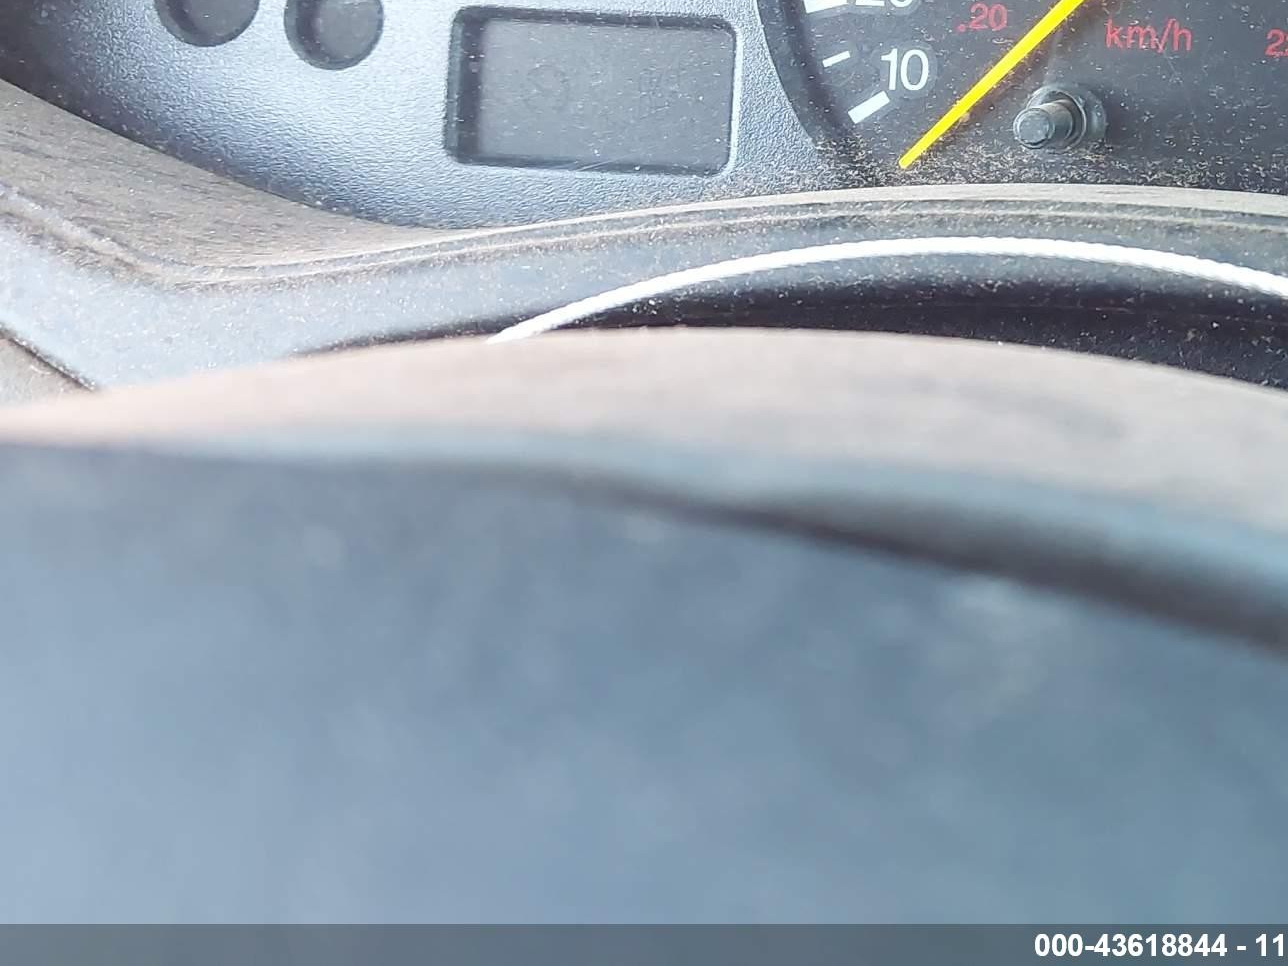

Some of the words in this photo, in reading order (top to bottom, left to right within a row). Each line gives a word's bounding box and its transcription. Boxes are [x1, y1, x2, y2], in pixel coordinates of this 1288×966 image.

[969, 4, 1008, 31] 20
[1105, 18, 1192, 52] km/h
[880, 49, 929, 91] 10
